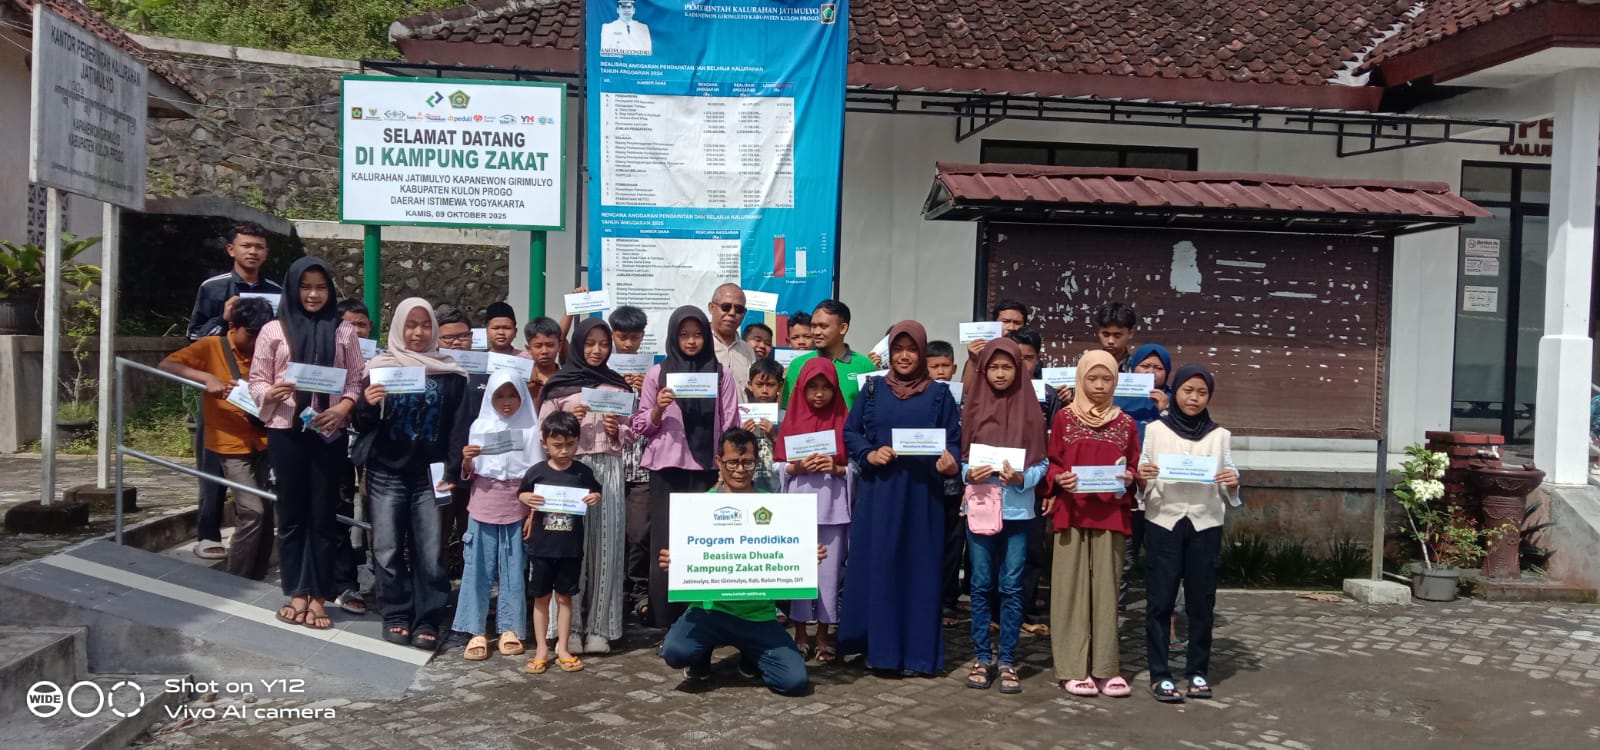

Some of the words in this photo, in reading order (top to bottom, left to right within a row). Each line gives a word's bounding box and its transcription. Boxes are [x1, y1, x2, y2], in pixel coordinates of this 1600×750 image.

[732, 5, 778, 14] KALURAHAN
[779, 7, 819, 15] JATIMULYO
[51, 25, 76, 55] KANTOR
[383, 127, 457, 146] SELAMAT
[462, 130, 526, 148] DATANG
[355, 146, 374, 166] DI
[381, 147, 479, 169] KAMPUNG
[484, 150, 549, 172] ZAKAT
[351, 172, 403, 182] KALURAHAN
[405, 174, 451, 184] JATIMULYO
[452, 175, 506, 185] KAPANEWON
[508, 177, 553, 187] GIRIMULYO
[400, 184, 450, 195] KABUPATEN
[451, 186, 480, 196] KULON
[482, 187, 513, 197] PROGO
[390, 195, 425, 206] DAERAH
[427, 197, 467, 207] ISTIMEWA
[468, 198, 525, 209] YOGYAKARTA
[405, 210, 434, 218] KAMIS,
[435, 210, 445, 218] 09
[446, 211, 487, 219] OKTOBER
[488, 212, 507, 220] 2025
[687, 535, 735, 547] Program
[740, 535, 800, 545] Pendidikan
[703, 551, 747, 560] Beasiswa
[749, 550, 784, 560] Dhuafa
[686, 563, 734, 574] Kampung
[735, 563, 763, 572] Zakat
[765, 562, 800, 572] Reborn
